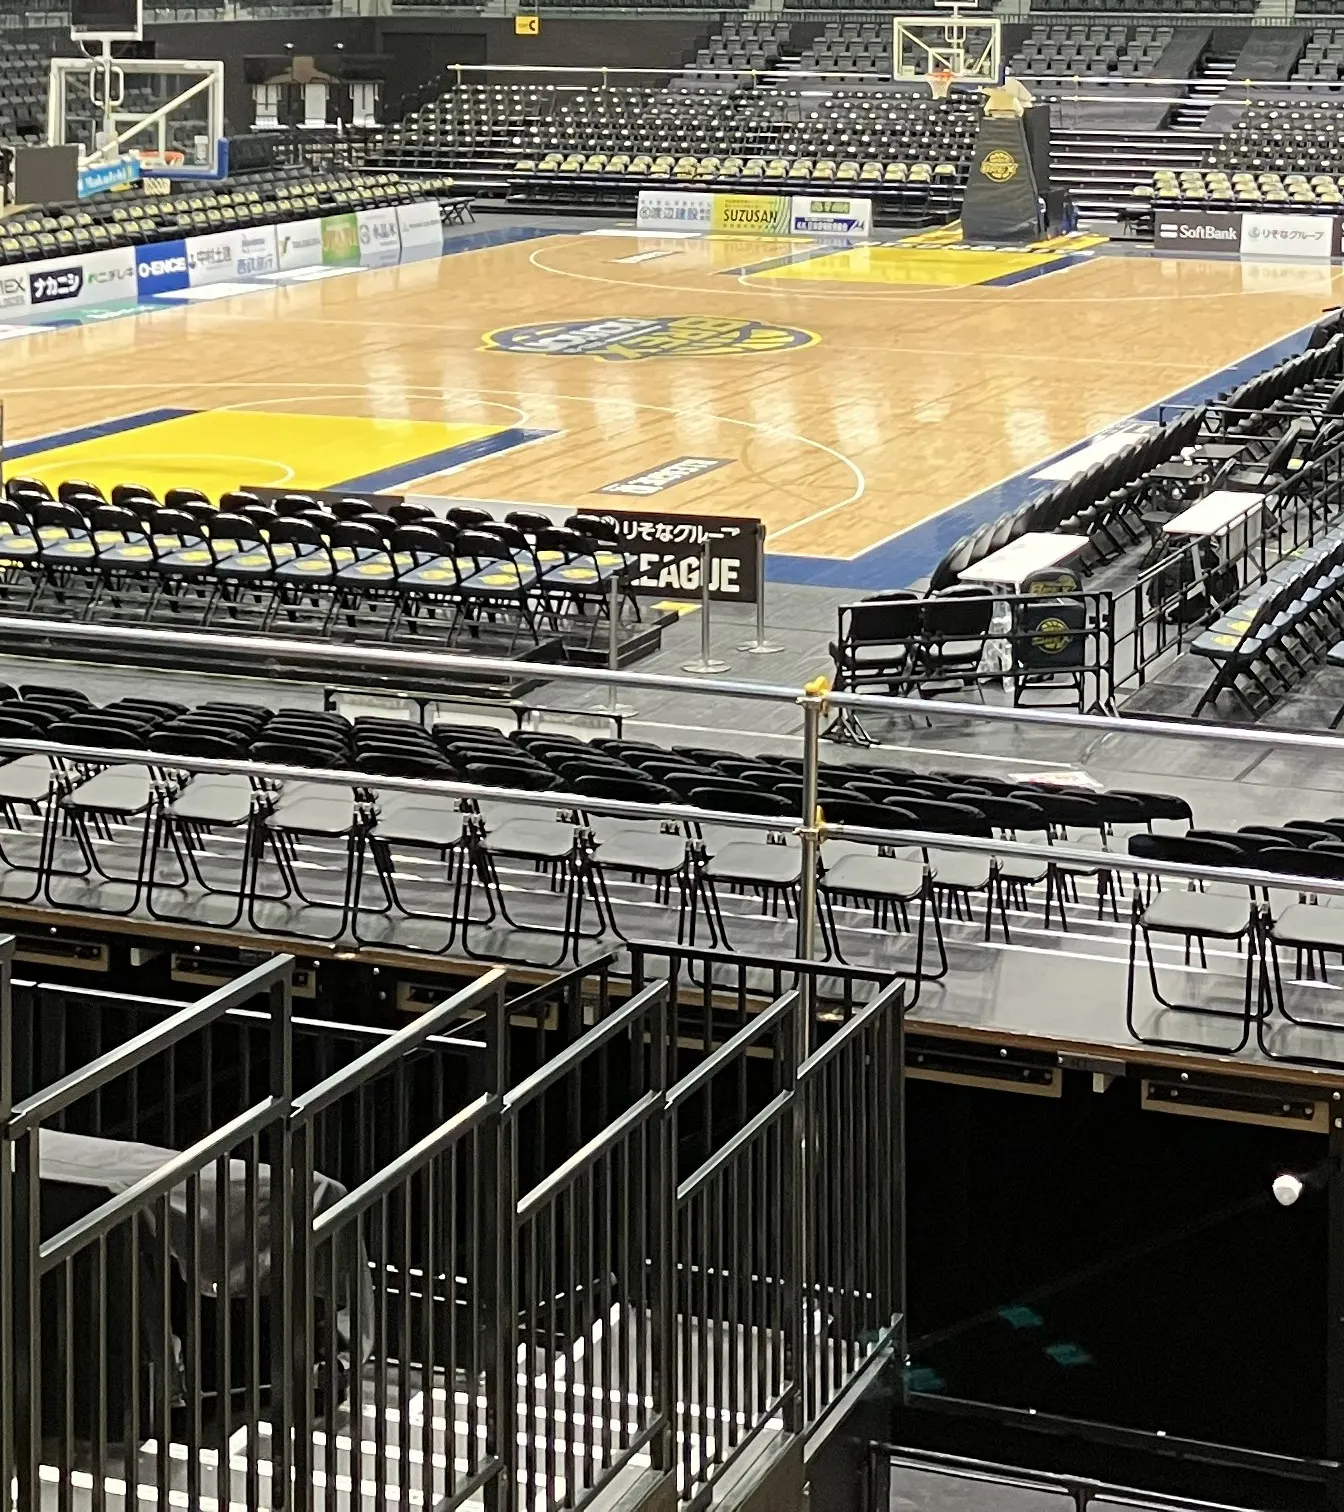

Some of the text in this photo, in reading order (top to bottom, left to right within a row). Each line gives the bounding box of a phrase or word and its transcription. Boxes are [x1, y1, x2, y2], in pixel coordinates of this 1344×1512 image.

[529, 20, 536, 31] C
[723, 208, 777, 224] SUZUSAN
[1179, 223, 1238, 241] SoftBank
[1260, 228, 1325, 242] りそなグループ
